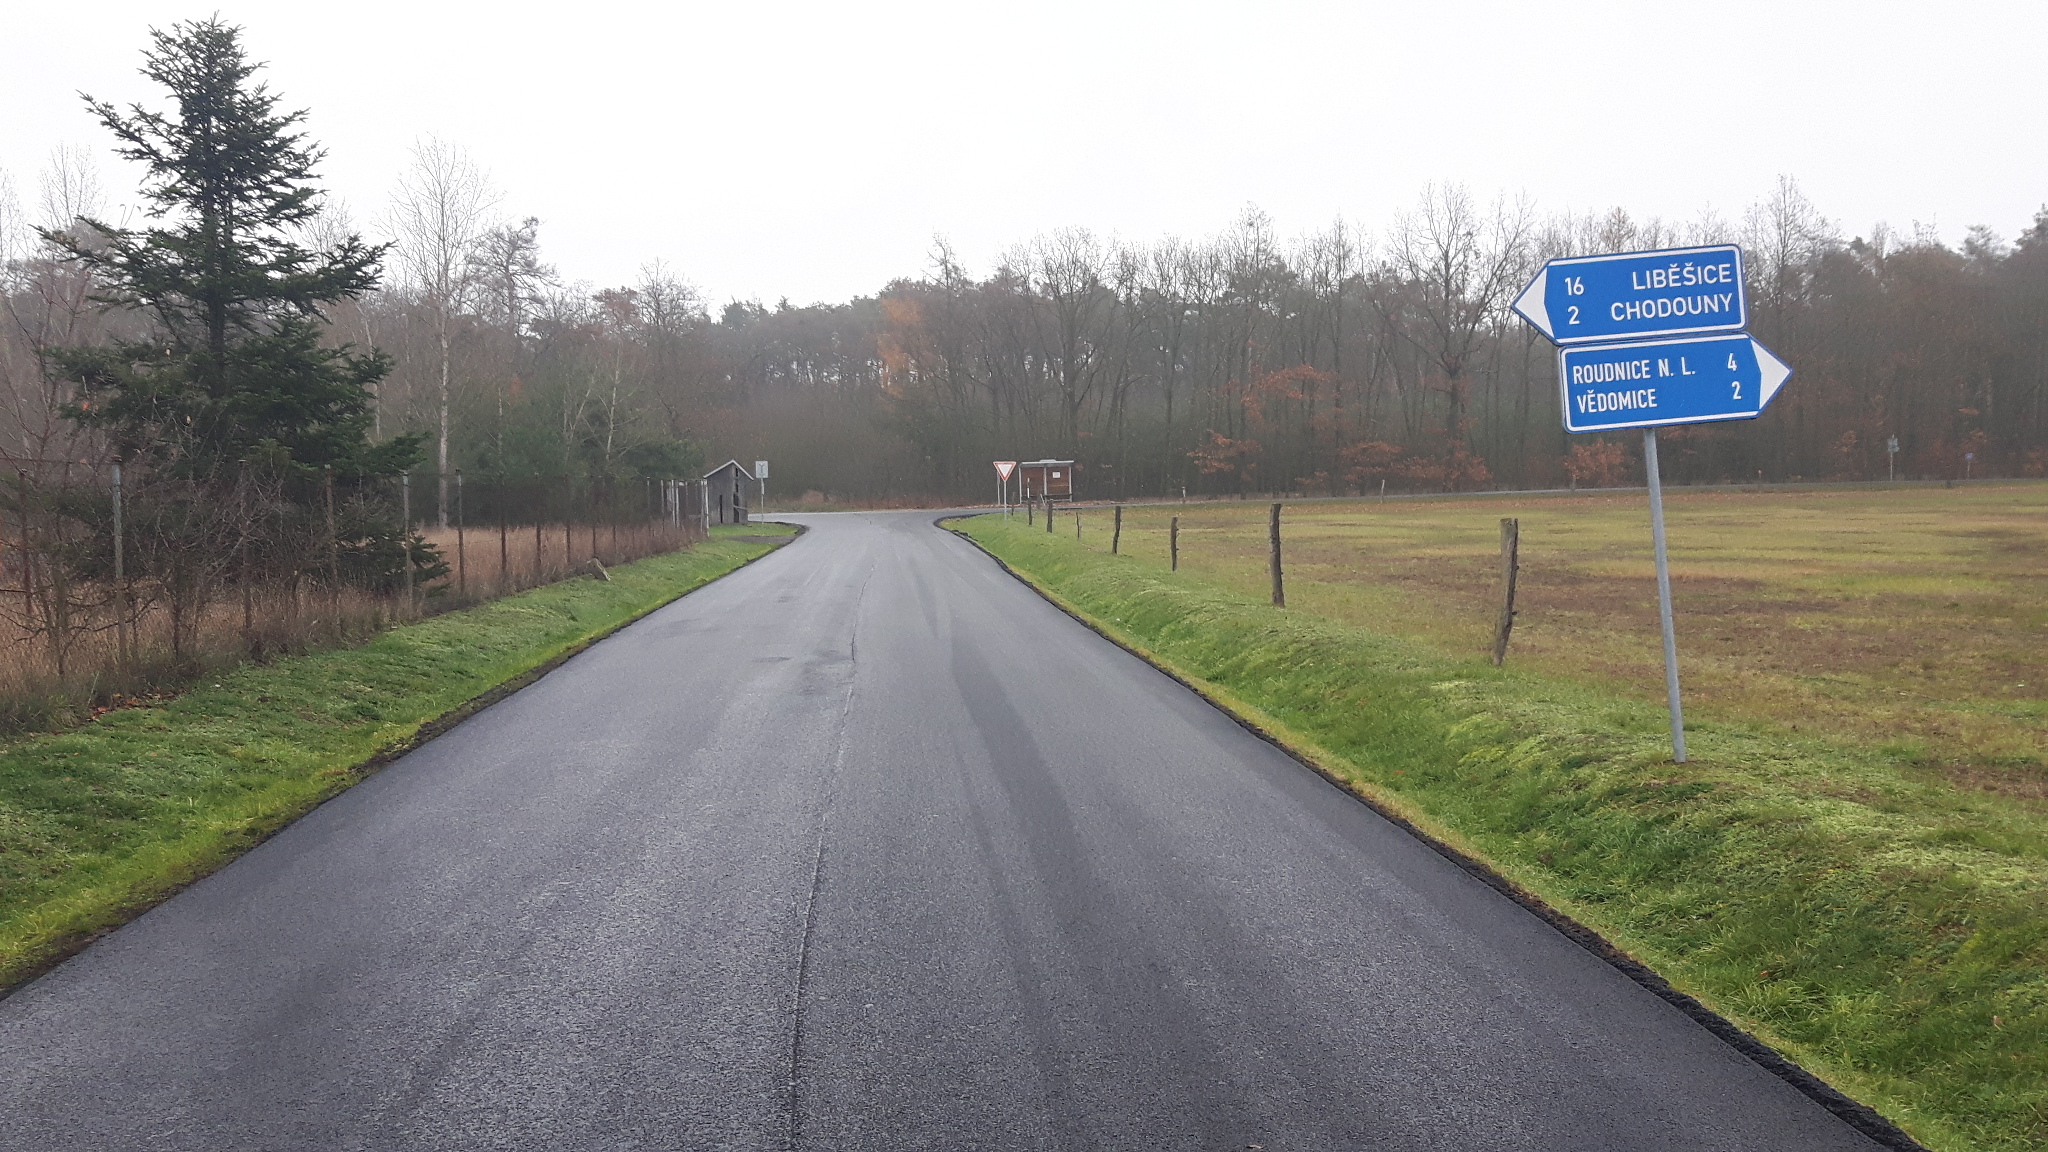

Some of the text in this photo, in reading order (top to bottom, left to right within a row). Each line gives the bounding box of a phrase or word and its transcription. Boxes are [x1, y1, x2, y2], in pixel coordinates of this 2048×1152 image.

[1565, 262, 1732, 295] 16 LIBĚŠICE
[1568, 293, 1732, 324] 2 CHODOUNY
[1573, 353, 1737, 384] ROUDNICE N. L. 4
[1577, 381, 1741, 413] VĚDOMICE 2
